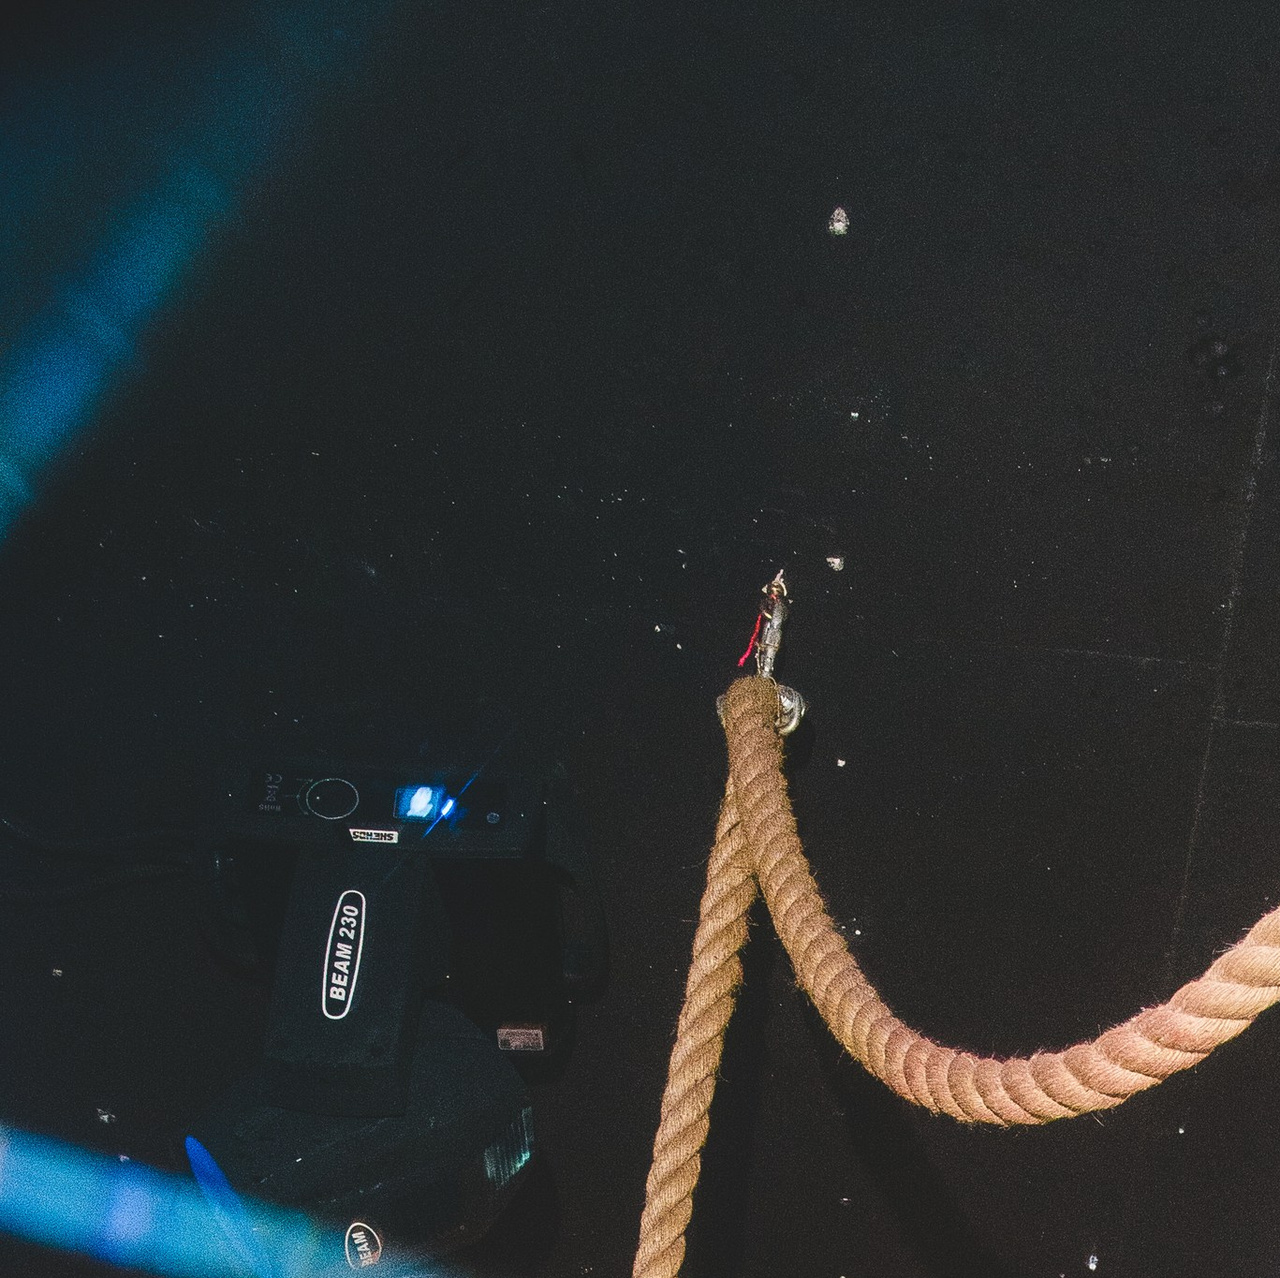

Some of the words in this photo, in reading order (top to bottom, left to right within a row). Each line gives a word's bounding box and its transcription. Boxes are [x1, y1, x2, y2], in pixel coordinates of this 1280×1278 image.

[338, 905, 359, 940] 230
[329, 942, 353, 1001] BEAM
[351, 1231, 374, 1268] BEAM
